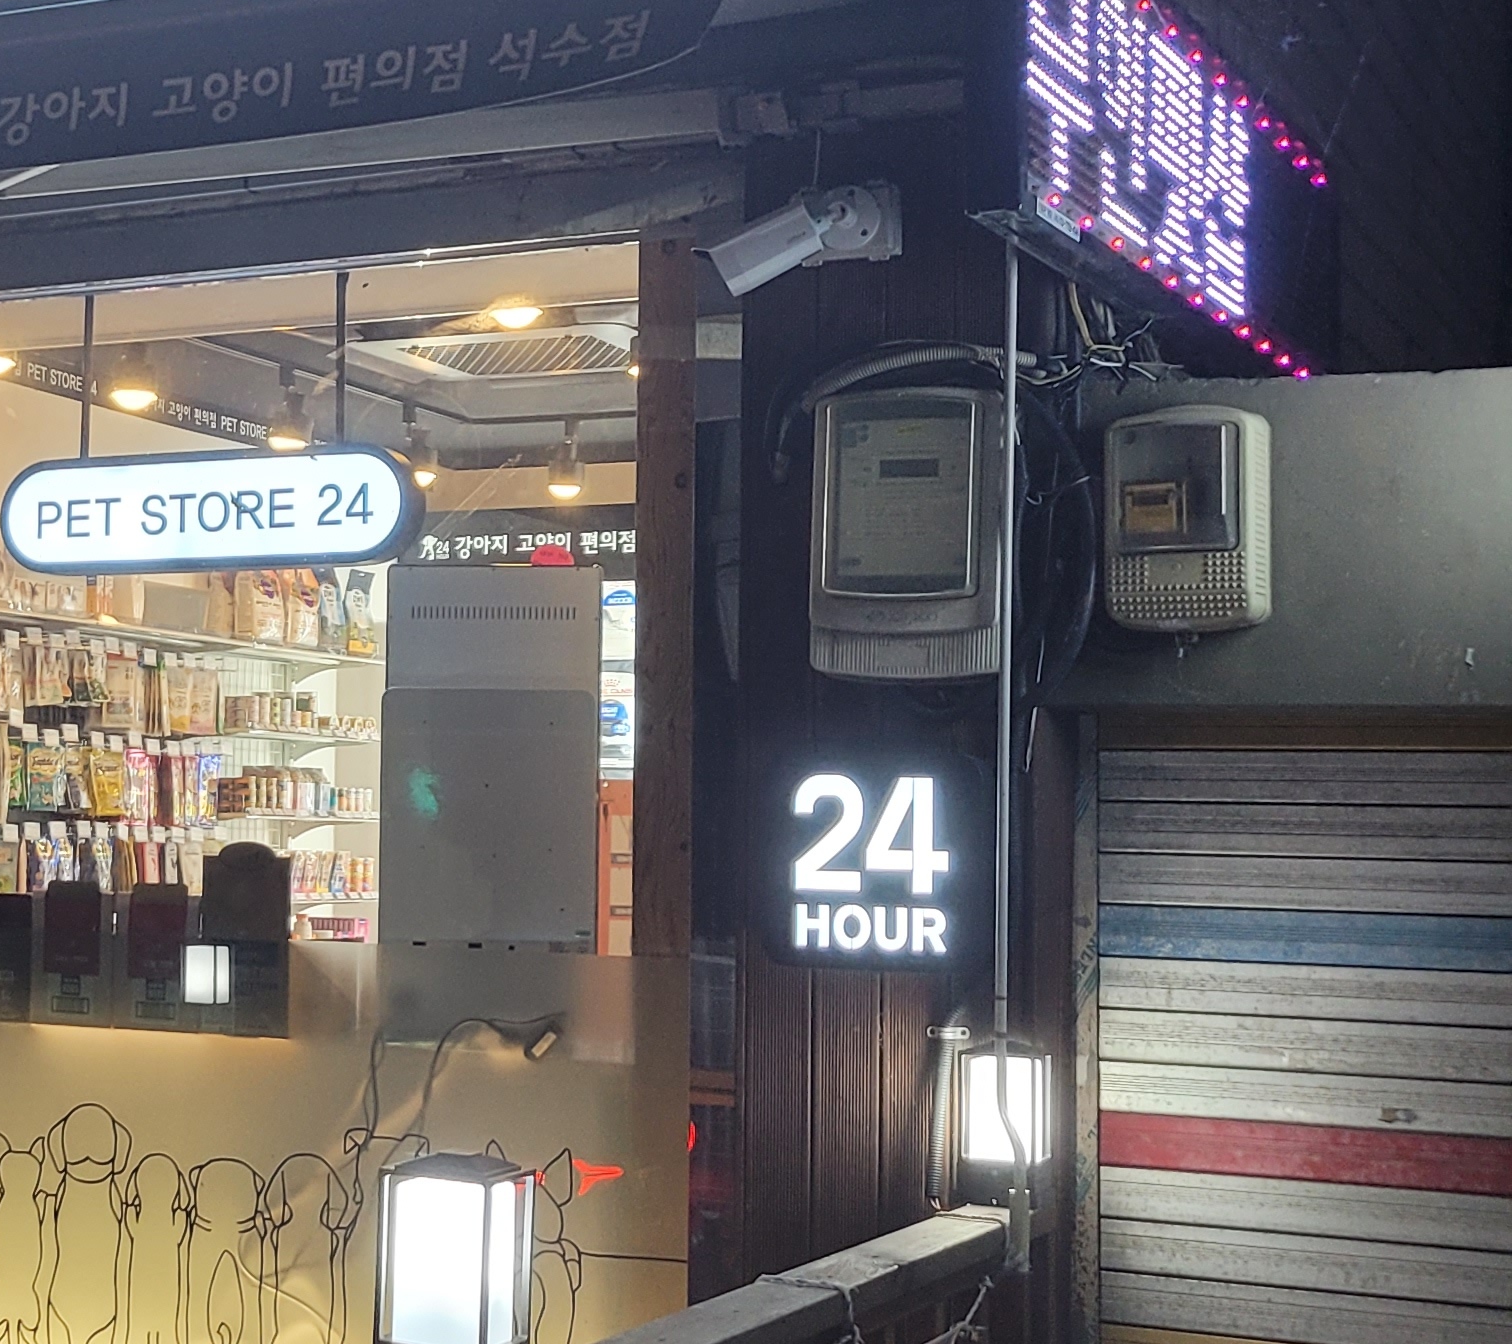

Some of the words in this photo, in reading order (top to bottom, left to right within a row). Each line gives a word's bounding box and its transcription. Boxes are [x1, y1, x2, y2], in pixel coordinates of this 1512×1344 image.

[152, 61, 293, 123] 고양이
[322, 40, 469, 108] 편의점
[489, 10, 652, 82] 석수점
[27, 361, 48, 383] PET
[50, 368, 84, 393] STORE
[220, 415, 238, 433] PET
[239, 419, 268, 441] STORE
[37, 497, 122, 540] PET
[140, 487, 296, 535] STORE
[316, 482, 375, 527] 24
[436, 540, 451, 555] 24
[454, 534, 509, 560] 강아지
[578, 529, 638, 555] 편의점
[793, 772, 951, 895] 24
[794, 902, 948, 954] HOUR
